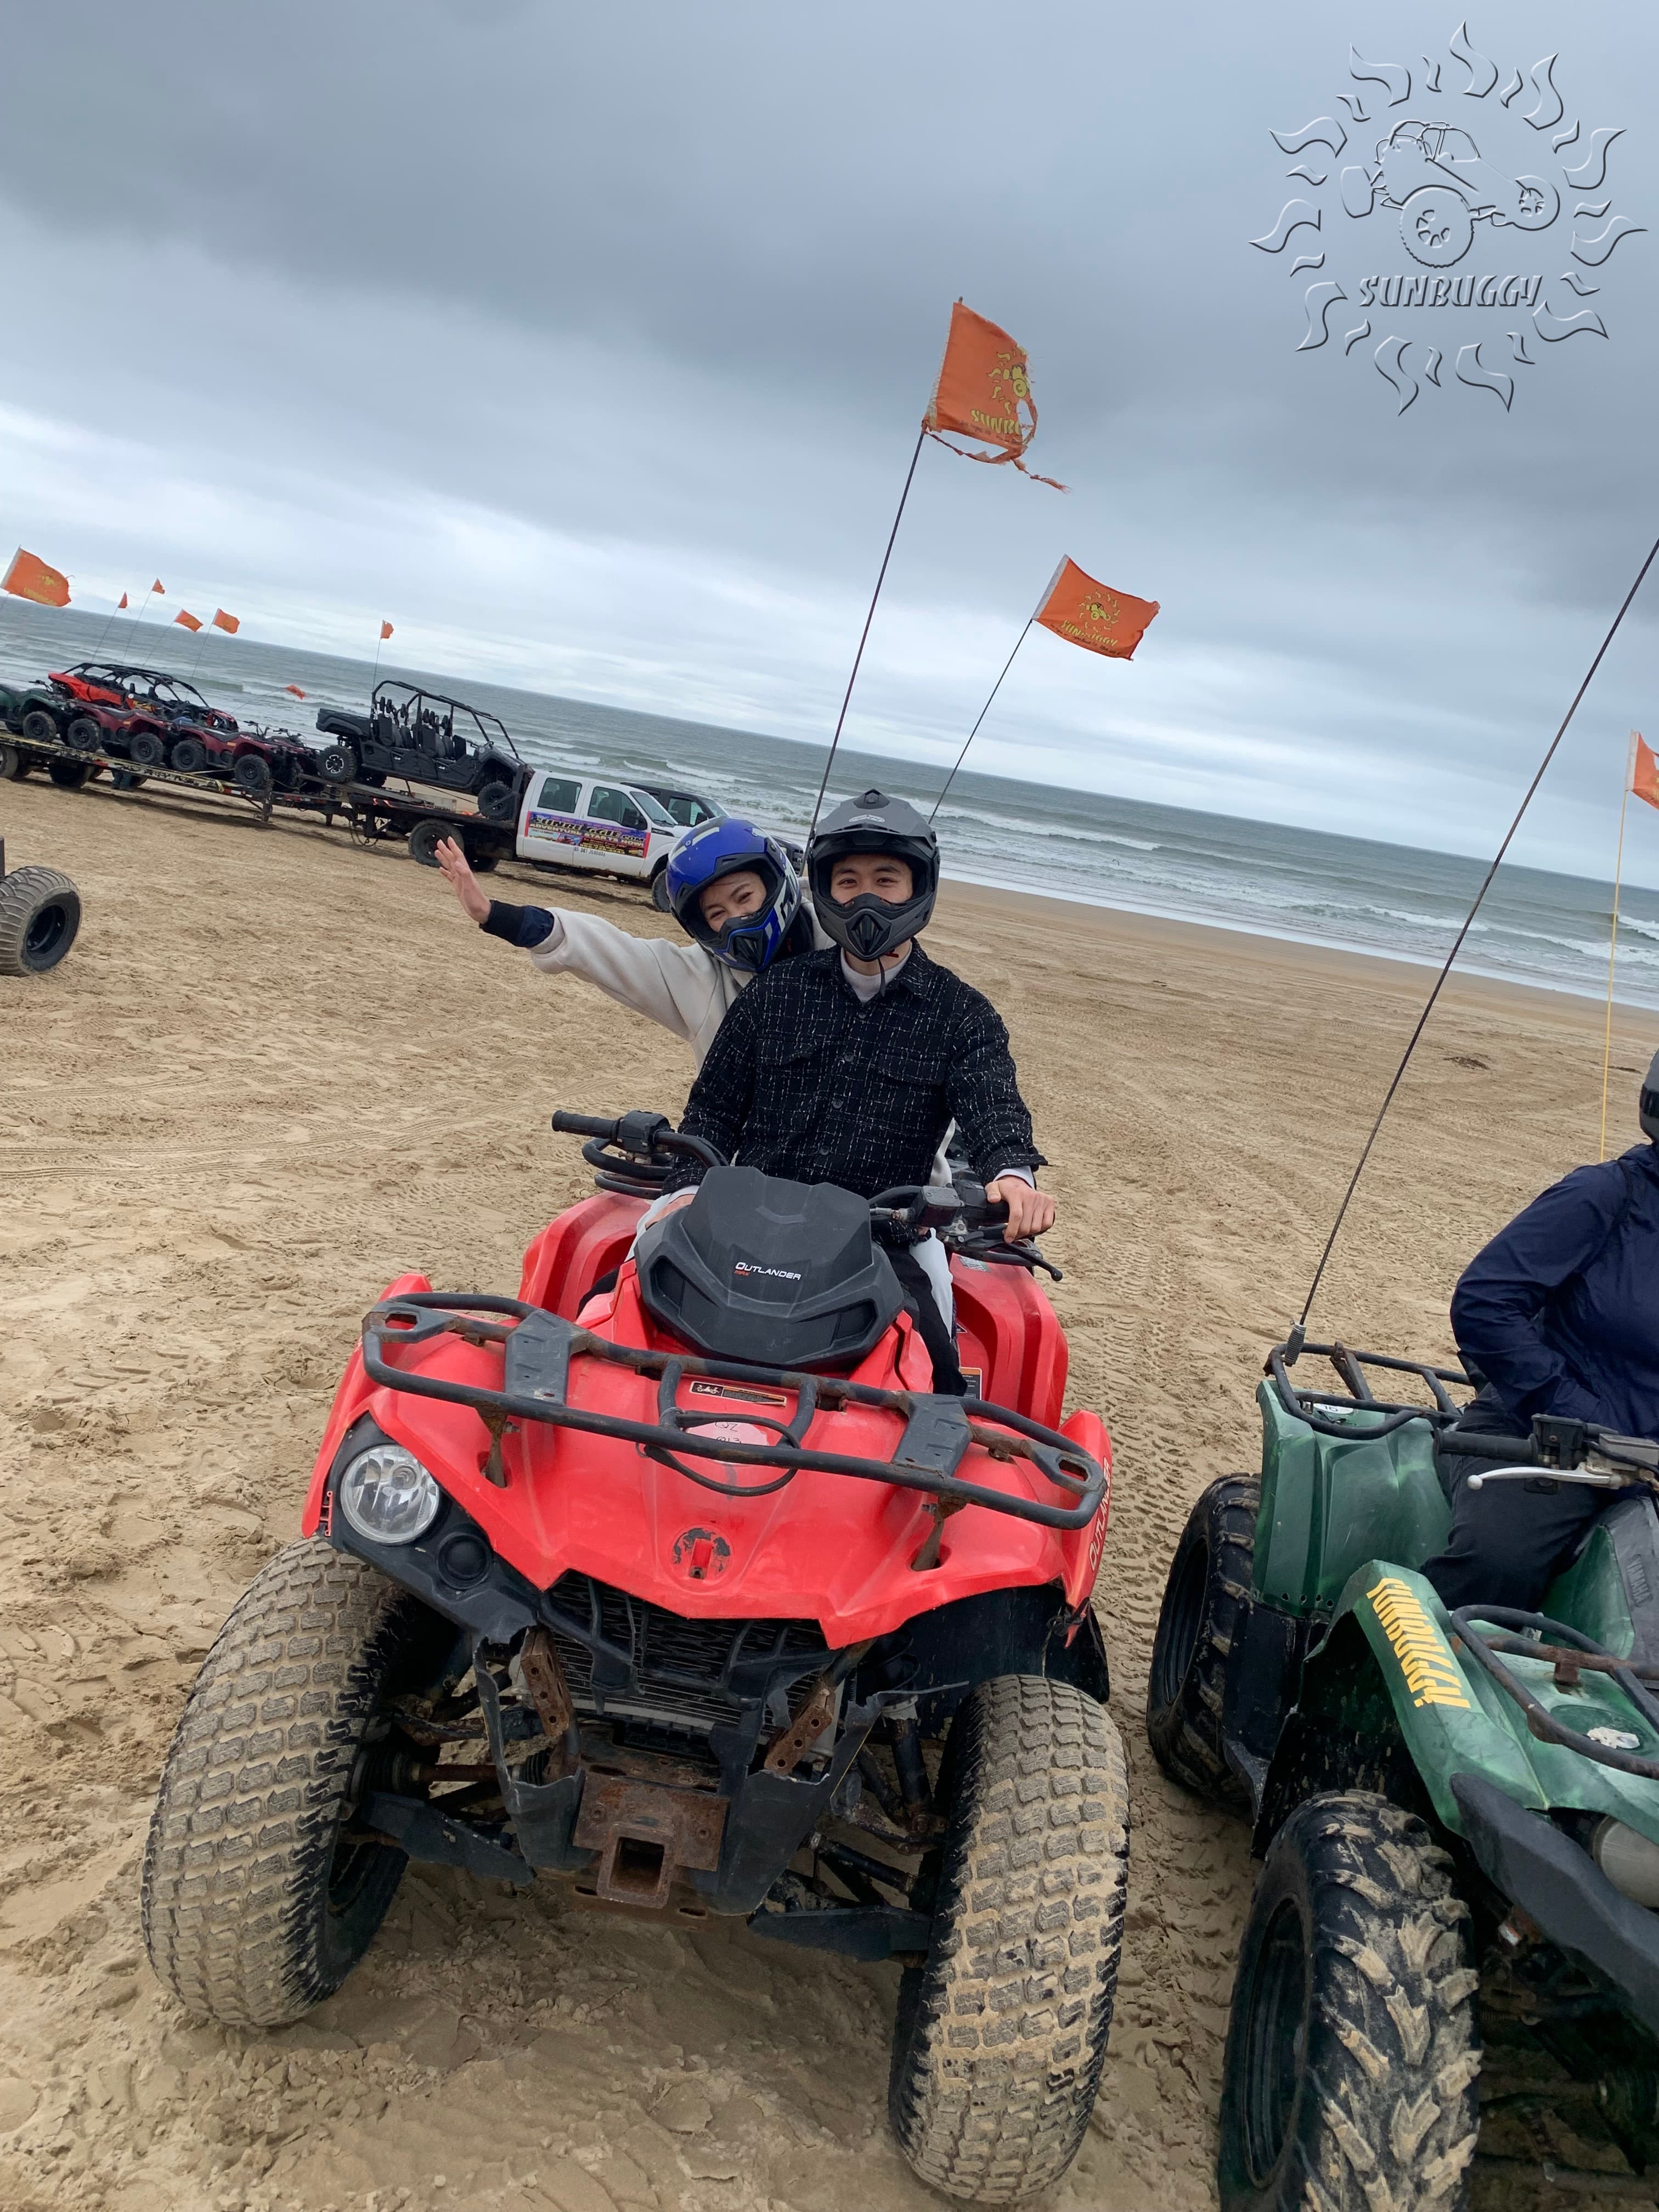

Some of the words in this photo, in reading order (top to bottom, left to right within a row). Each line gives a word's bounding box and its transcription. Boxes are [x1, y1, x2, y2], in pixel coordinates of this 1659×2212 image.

[735, 1262, 802, 1280] OUTLANDER
[1089, 1457, 1111, 1571] OUTLANER
[1626, 1557, 1650, 1603] YAMAHA
[1366, 1578, 1471, 1707] SUNBUGGY
